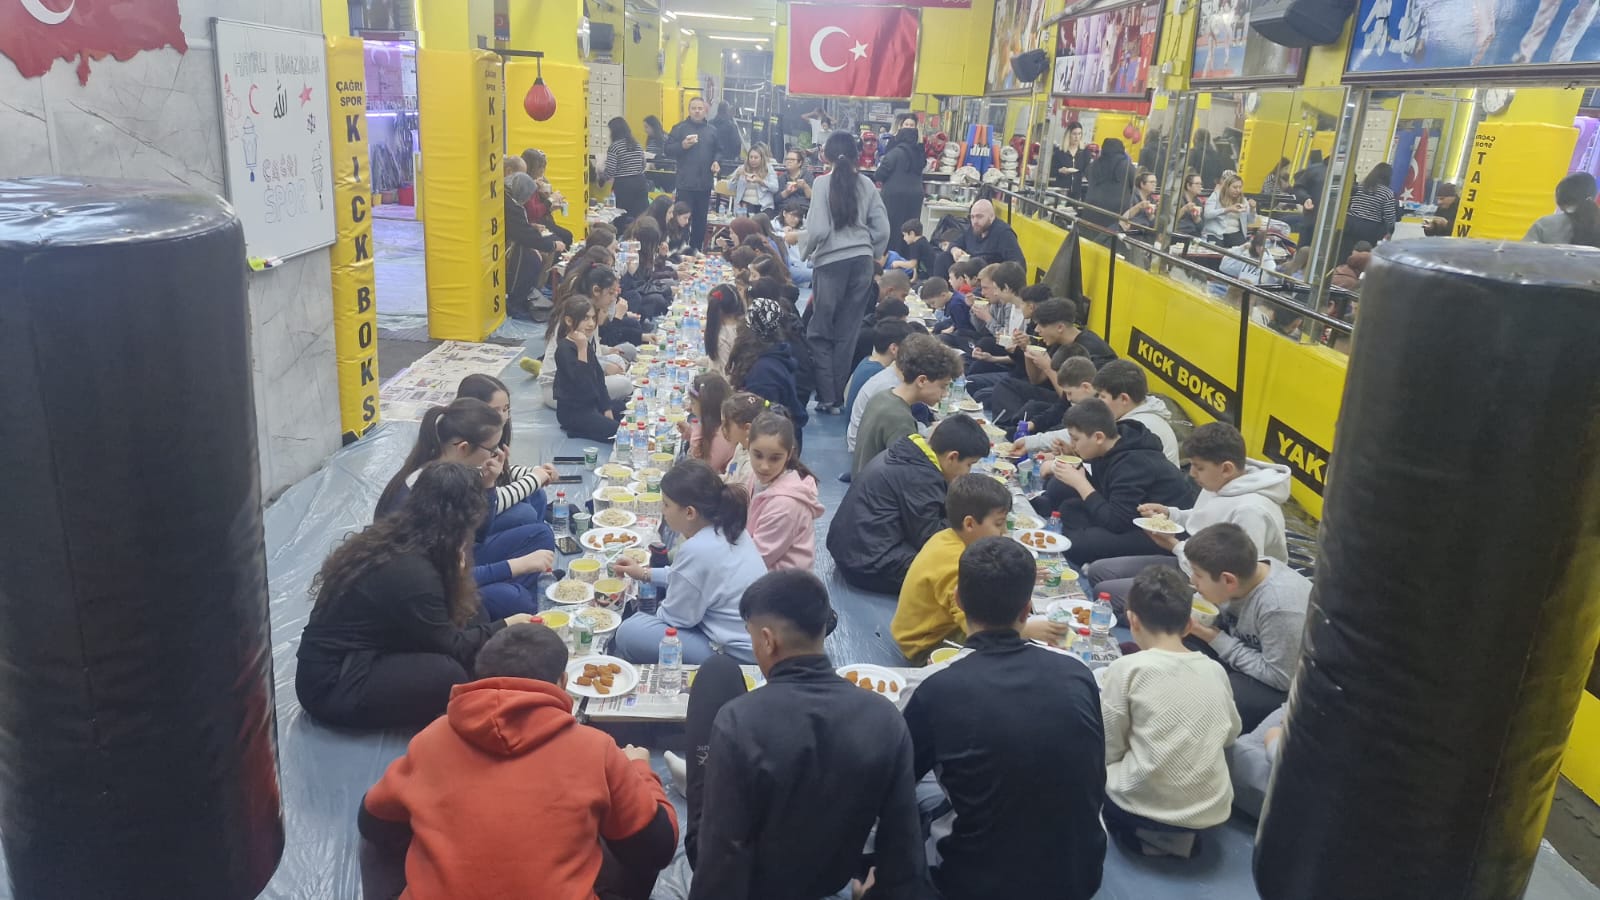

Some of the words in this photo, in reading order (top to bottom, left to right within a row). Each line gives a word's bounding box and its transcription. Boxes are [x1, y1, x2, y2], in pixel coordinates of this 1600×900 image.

[336, 80, 363, 93] ÇAĞRI
[340, 96, 362, 107] SPOR
[488, 97, 497, 199] KICK
[345, 114, 369, 262] KICK
[357, 286, 376, 422] BOKS
[491, 217, 500, 313] BOKS
[1137, 340, 1175, 377] KICK
[1177, 366, 1227, 413] BOKS
[1278, 432, 1329, 487] YAK
